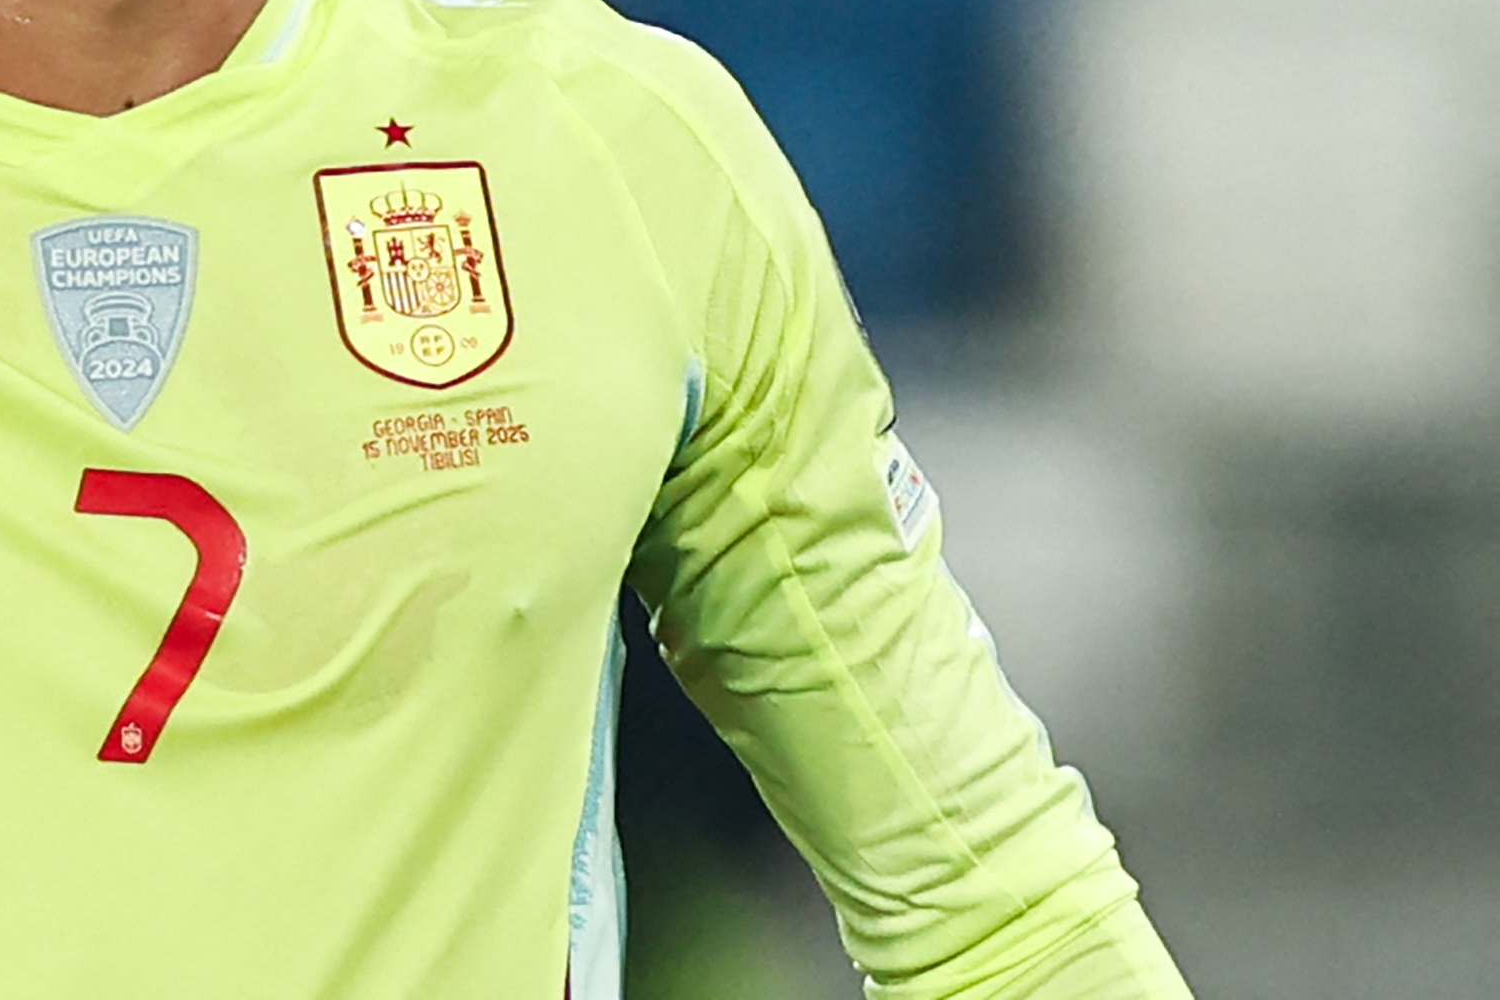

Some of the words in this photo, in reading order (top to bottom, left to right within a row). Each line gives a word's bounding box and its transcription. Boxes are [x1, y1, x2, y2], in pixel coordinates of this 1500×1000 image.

[87, 228, 139, 244] UEFA
[51, 245, 180, 268] EUROPEAN
[51, 266, 182, 288] CHAMPIONS
[89, 358, 154, 380] 2024
[372, 413, 446, 438] GEORGIA
[464, 406, 514, 427] SPAIN
[362, 440, 381, 460] 15
[386, 428, 481, 456] NOVEMBER
[486, 424, 531, 446] 2025
[74, 467, 247, 764] 7
